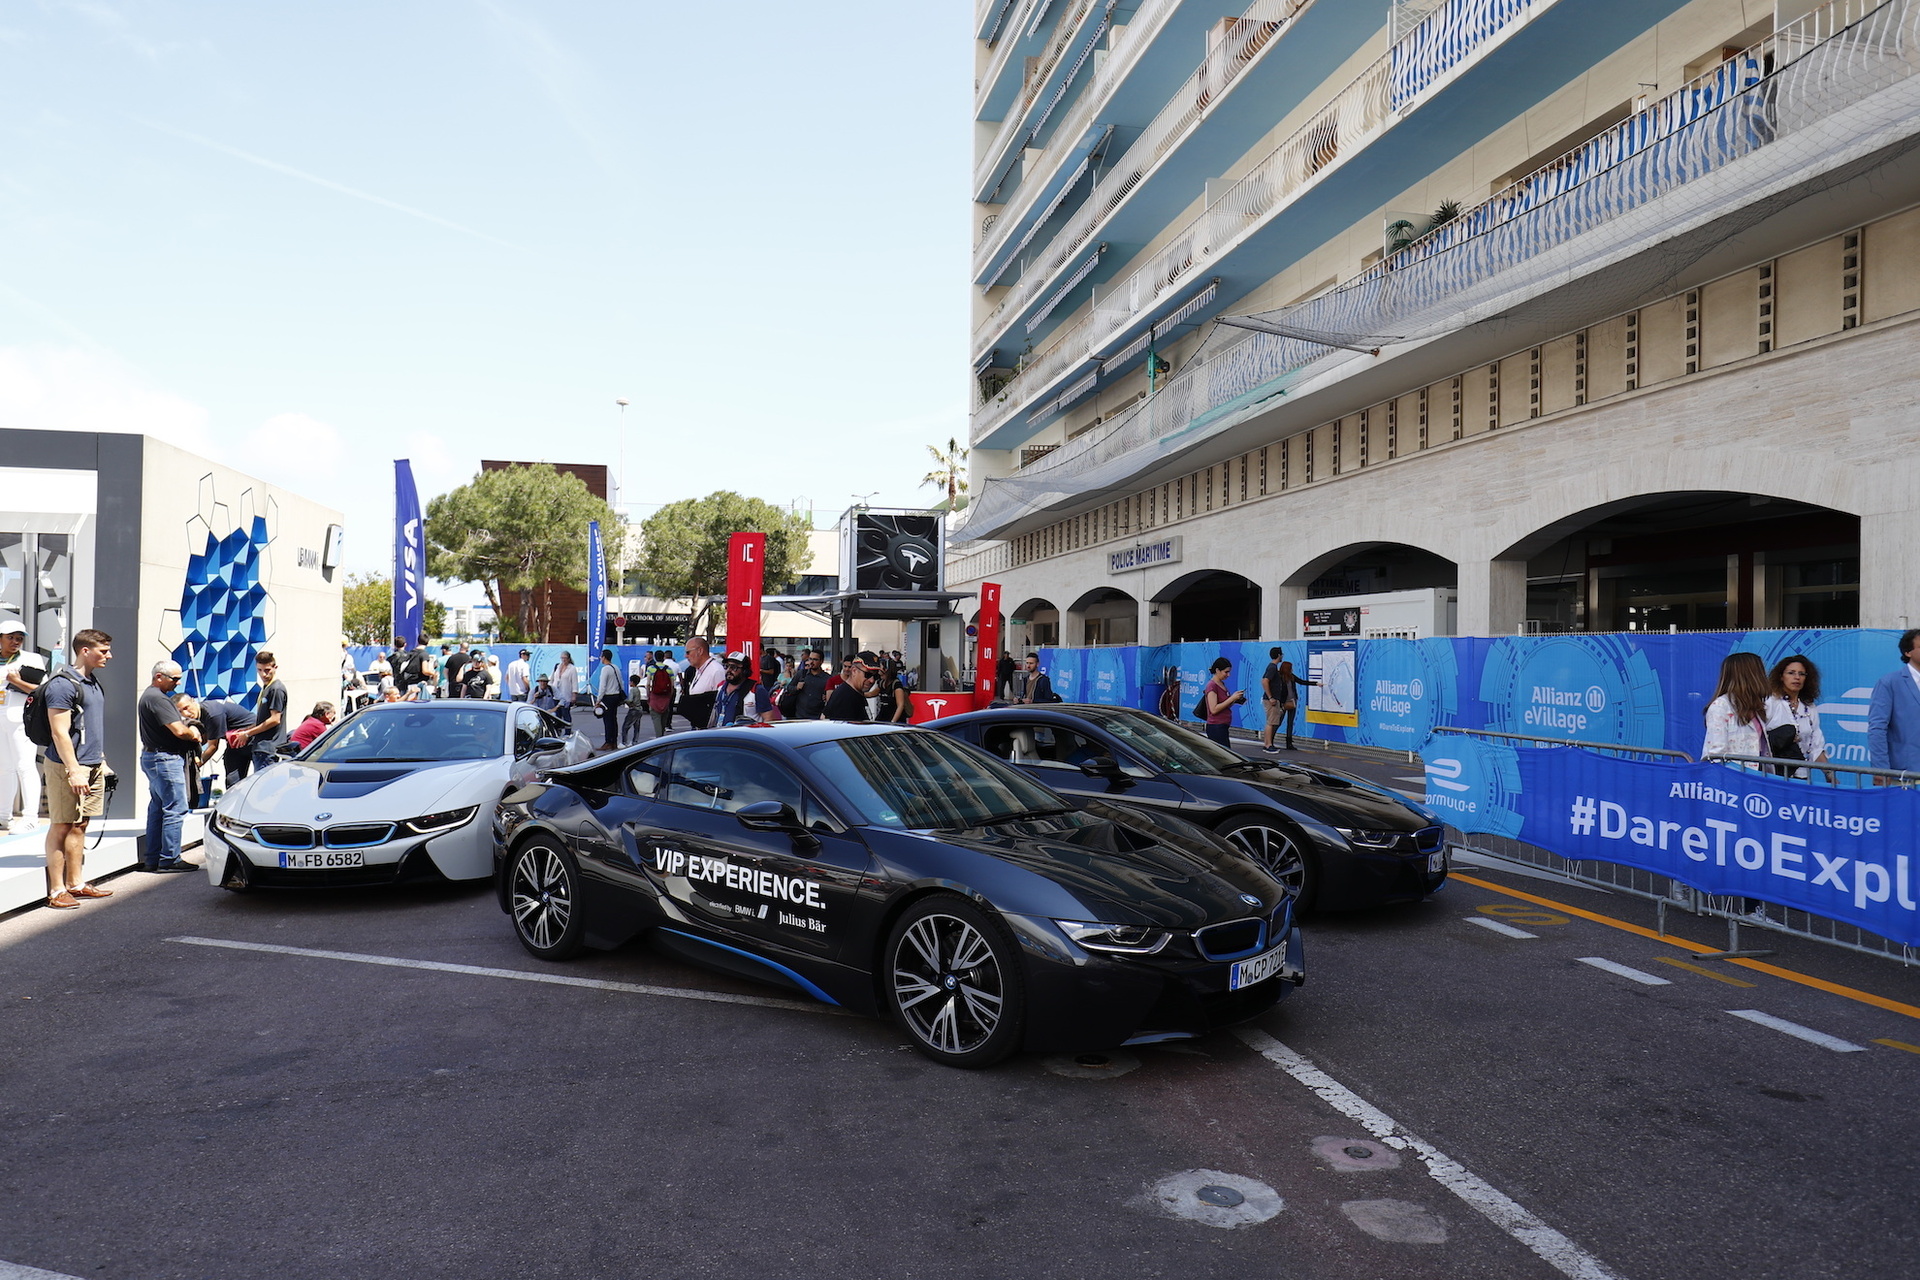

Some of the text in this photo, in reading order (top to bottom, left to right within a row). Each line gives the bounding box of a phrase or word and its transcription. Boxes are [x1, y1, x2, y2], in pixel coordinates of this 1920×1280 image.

[404, 518, 419, 619] VISA
[1111, 541, 1171, 570] POLICE MARITIME
[594, 603, 603, 649] Allianz
[1375, 680, 1408, 695] Allianz
[1531, 686, 1583, 707] Allianz
[1370, 696, 1411, 717] eVillage
[1524, 706, 1587, 734] eVillage
[1669, 782, 1881, 836] Allianz eVillage
[287, 852, 362, 867] M FB 6582
[1570, 795, 1917, 912] #DareToExpl
[655, 847, 826, 909] VIP EXPERIENCE.
[734, 904, 752, 917] BMW
[778, 910, 828, 934] Julius Bär
[1239, 964, 1249, 986] M
[1253, 958, 1267, 980] CP
